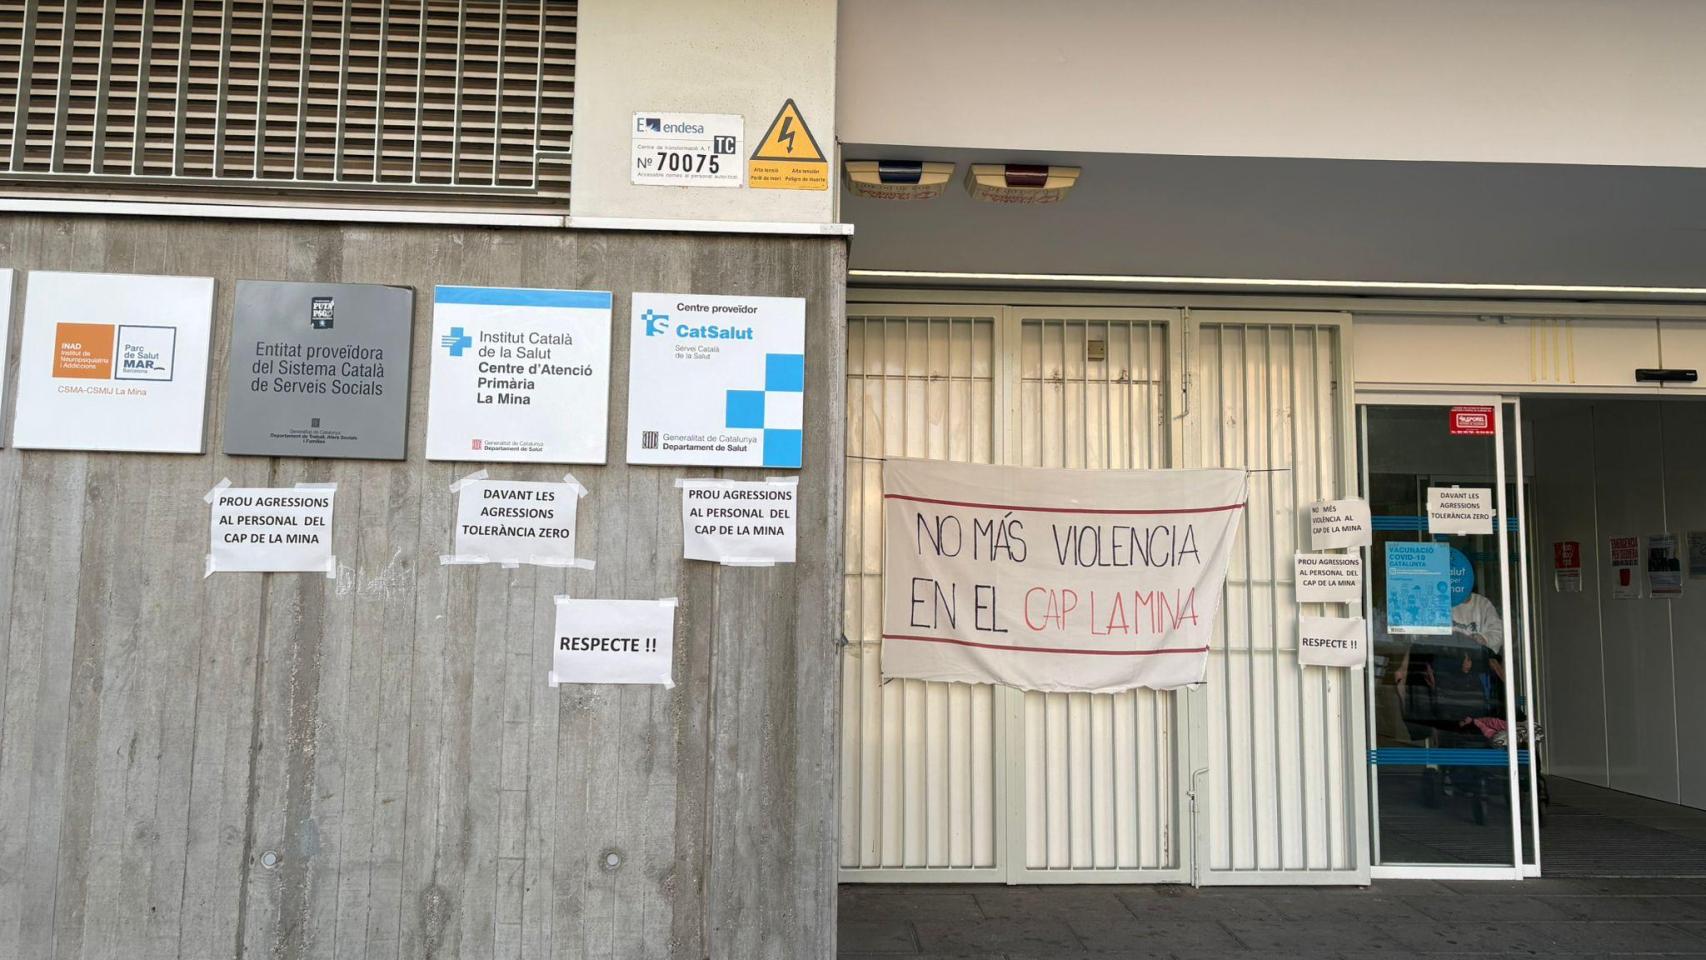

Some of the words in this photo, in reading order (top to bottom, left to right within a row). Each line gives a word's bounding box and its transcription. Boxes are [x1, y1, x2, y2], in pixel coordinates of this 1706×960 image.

[663, 122, 704, 134] endesa
[716, 137, 734, 153] TC
[637, 158, 652, 168] Nº
[657, 152, 719, 173] 70075
[677, 303, 709, 312] Centre
[712, 305, 758, 314] proveïdor
[480, 331, 524, 343] Institut
[529, 332, 572, 345] Català
[676, 324, 753, 340] CatSalut
[256, 342, 301, 357] Entitat
[306, 344, 383, 360] proveïdora
[478, 346, 495, 358] de
[500, 347, 511, 358] la
[516, 347, 551, 359] Salut
[124, 360, 154, 369] MAR
[252, 360, 273, 374] del
[279, 360, 336, 376] Sistema
[342, 362, 384, 377] Català
[478, 362, 524, 374] Centre
[528, 364, 593, 376] d'Atenció
[251, 378, 268, 392] de
[273, 378, 326, 394] Serveis
[332, 380, 383, 396] Socials
[478, 378, 534, 389] Primària
[116, 387, 125, 395] La
[477, 393, 492, 403] La
[498, 393, 530, 405] Mina
[719, 435, 757, 444] Catalunya
[663, 443, 713, 451] Departament
[484, 489, 533, 500] DAVANT
[536, 492, 555, 501] LES
[689, 490, 720, 499] PROU
[723, 490, 792, 500] AGRESSIONS
[219, 497, 252, 506] PROU
[256, 497, 328, 508] AGRESSIONS
[481, 507, 554, 519] AGRESSIONS
[690, 508, 703, 517] AL
[707, 508, 764, 518] PERSONAL
[770, 509, 790, 518] DEL
[219, 516, 234, 525] AL
[237, 516, 298, 526] PERSONAL
[304, 517, 325, 526] DEL
[462, 524, 536, 537] TOLERÀNCIA
[538, 528, 570, 539] ZERO
[695, 525, 716, 534] CAP
[720, 526, 733, 535] DE
[737, 526, 750, 535] LA
[753, 526, 784, 535] MINA
[224, 534, 247, 543] CAP
[250, 534, 265, 543] DE
[269, 534, 283, 543] LA
[286, 534, 319, 544] MINA
[917, 512, 961, 557] NO
[974, 511, 1027, 563] MÁS
[1052, 524, 1200, 568] VIOLENCIA
[910, 577, 956, 630] EN
[975, 585, 1008, 632] EL
[1024, 586, 1078, 631] CAP
[1091, 590, 1130, 635] LA
[1135, 587, 1198, 635] MINA
[560, 637, 640, 652] RESPECTE
[646, 638, 656, 652] !!
[1303, 638, 1347, 648] RESPECTE
[1351, 640, 1357, 649] !!
